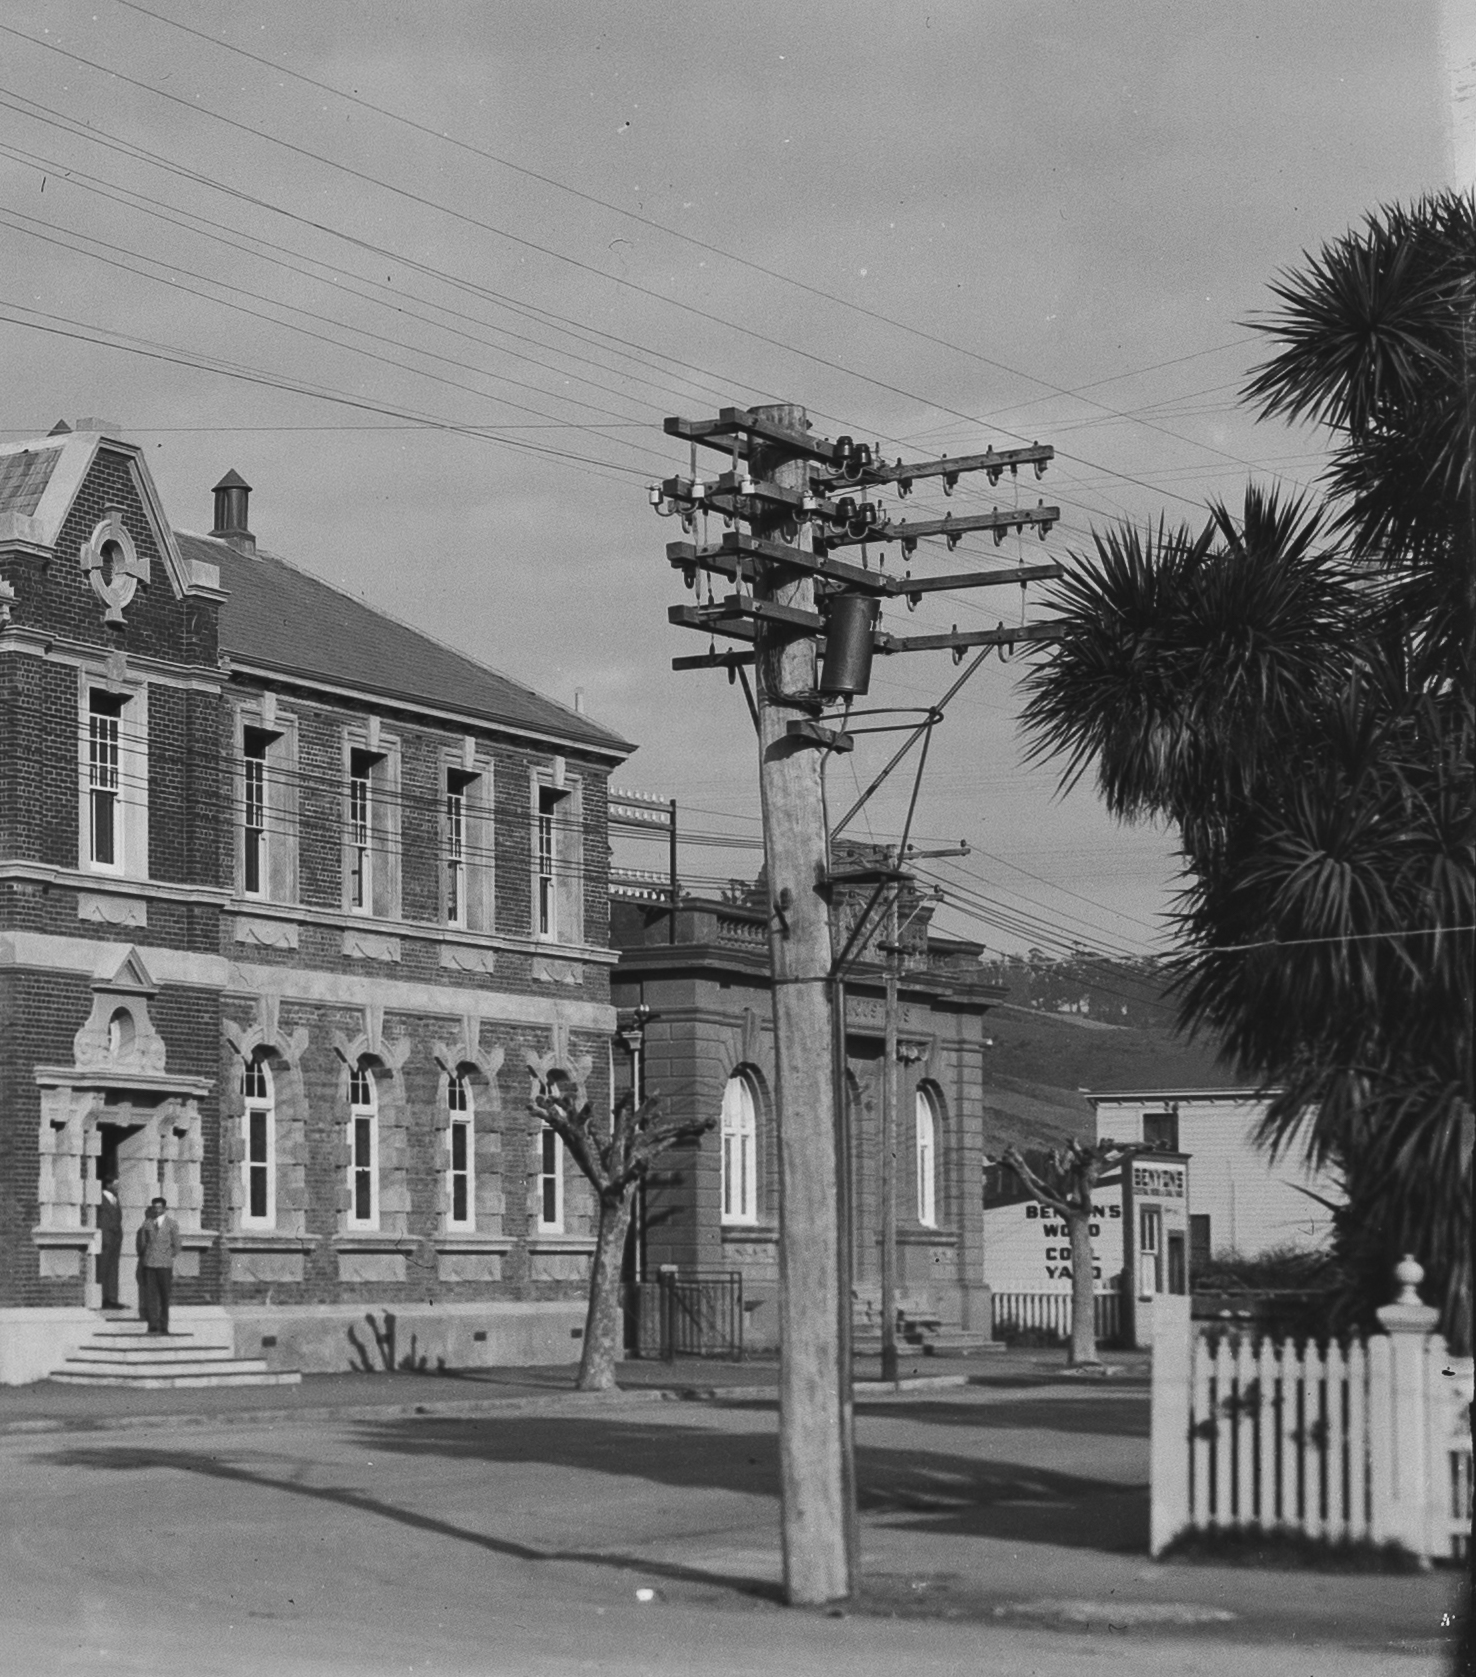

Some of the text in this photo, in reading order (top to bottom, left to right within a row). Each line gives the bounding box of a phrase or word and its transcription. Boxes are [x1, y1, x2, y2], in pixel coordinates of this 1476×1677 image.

[1026, 1205, 1121, 1219] BEN'S
[1043, 1223, 1100, 1237] WOD
[1045, 1247, 1101, 1261] CO
[1045, 1266, 1102, 1280] YAD
